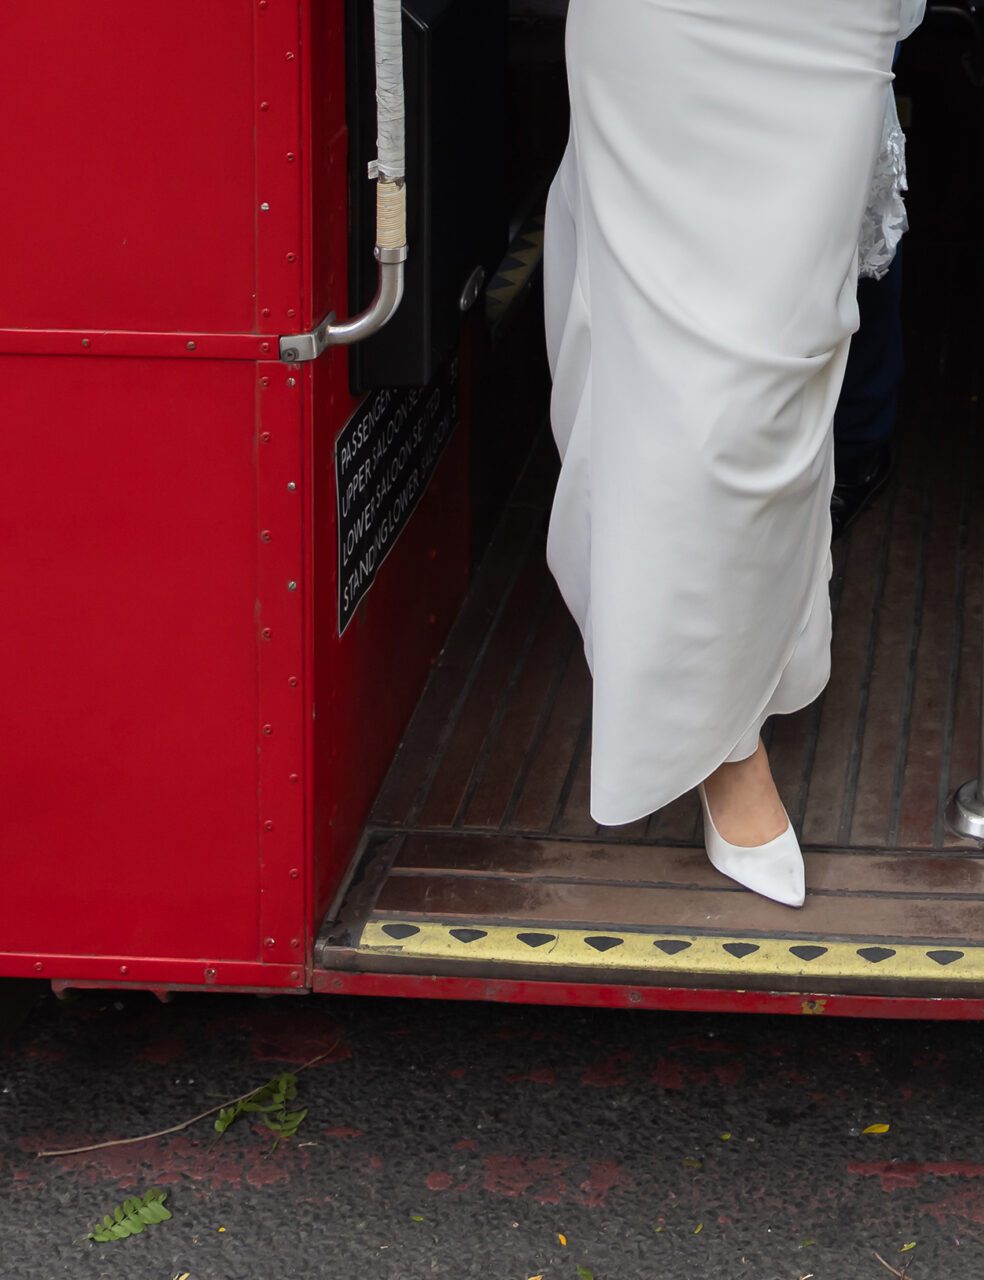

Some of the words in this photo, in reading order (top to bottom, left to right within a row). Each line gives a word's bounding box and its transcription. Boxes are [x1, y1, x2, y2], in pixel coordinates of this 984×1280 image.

[342, 458, 371, 518] UPPER
[372, 396, 408, 470] SALOON
[343, 496, 376, 567] LOWER
[376, 434, 412, 508] SALOON
[344, 518, 388, 612] STANDING
[389, 468, 419, 532] LOWER
